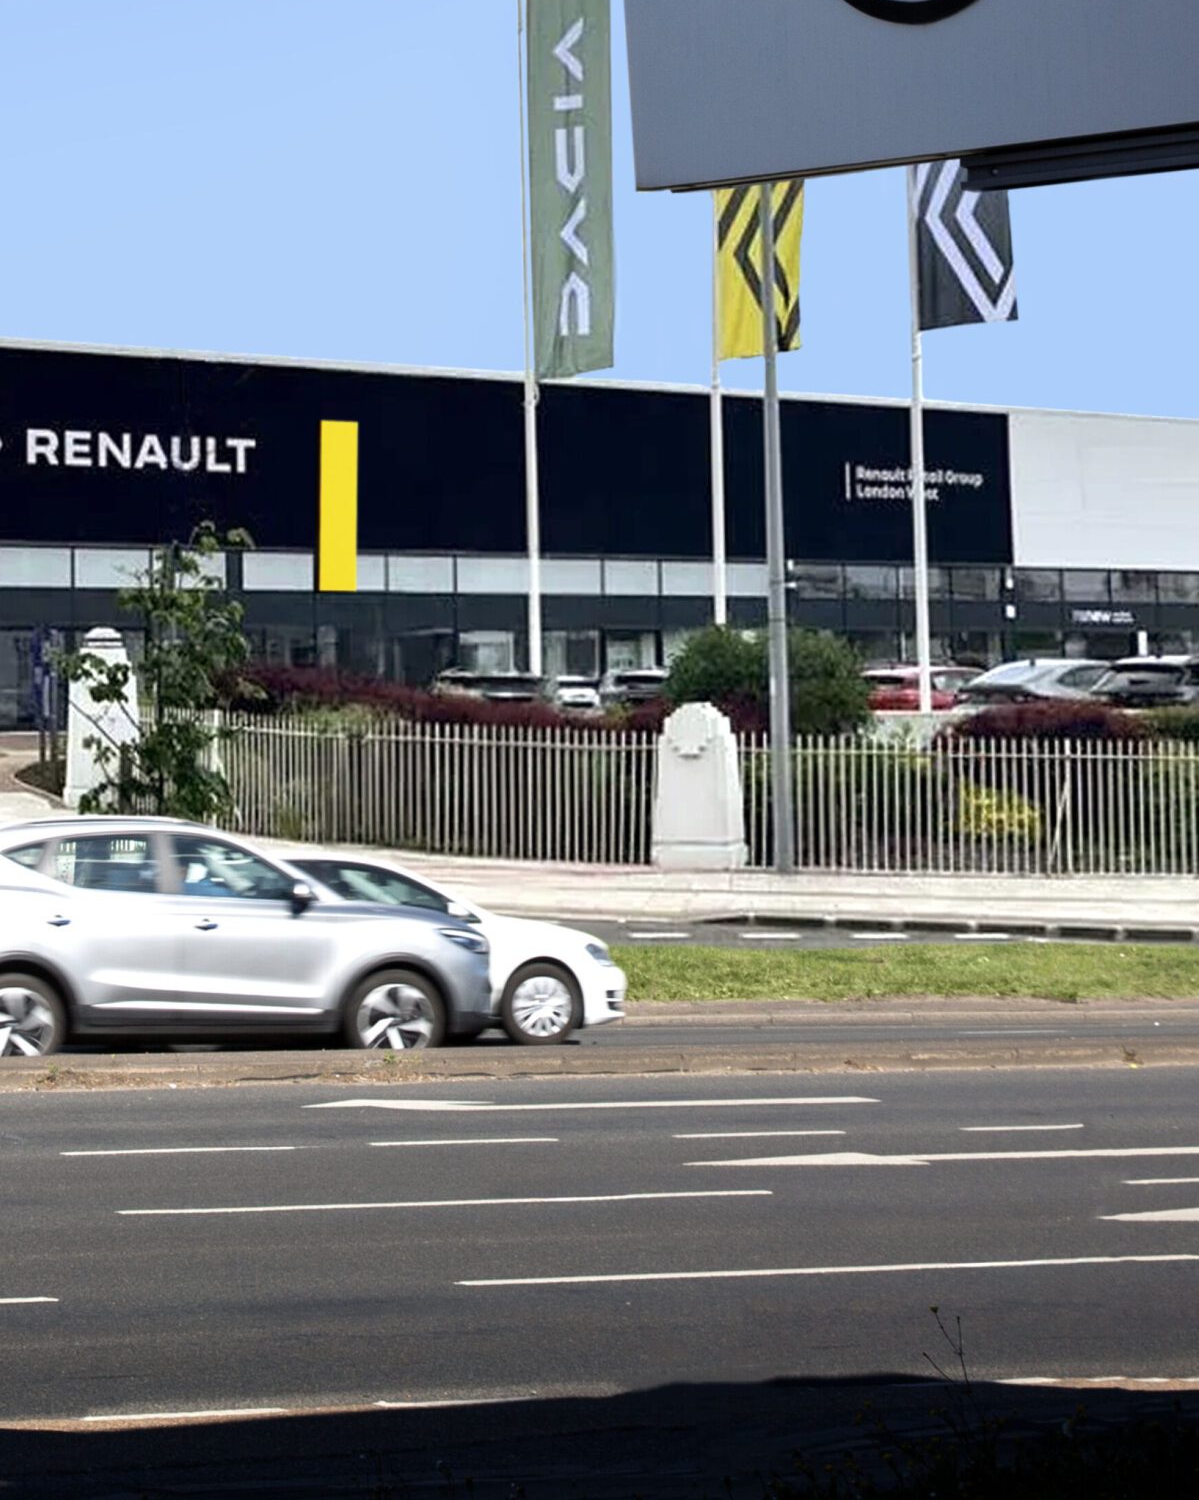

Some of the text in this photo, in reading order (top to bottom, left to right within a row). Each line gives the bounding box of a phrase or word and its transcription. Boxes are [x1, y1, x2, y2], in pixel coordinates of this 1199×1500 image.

[26, 428, 256, 473] RENAULT
[856, 466, 905, 481] Renault
[945, 469, 983, 488] Group
[856, 484, 905, 500] London
